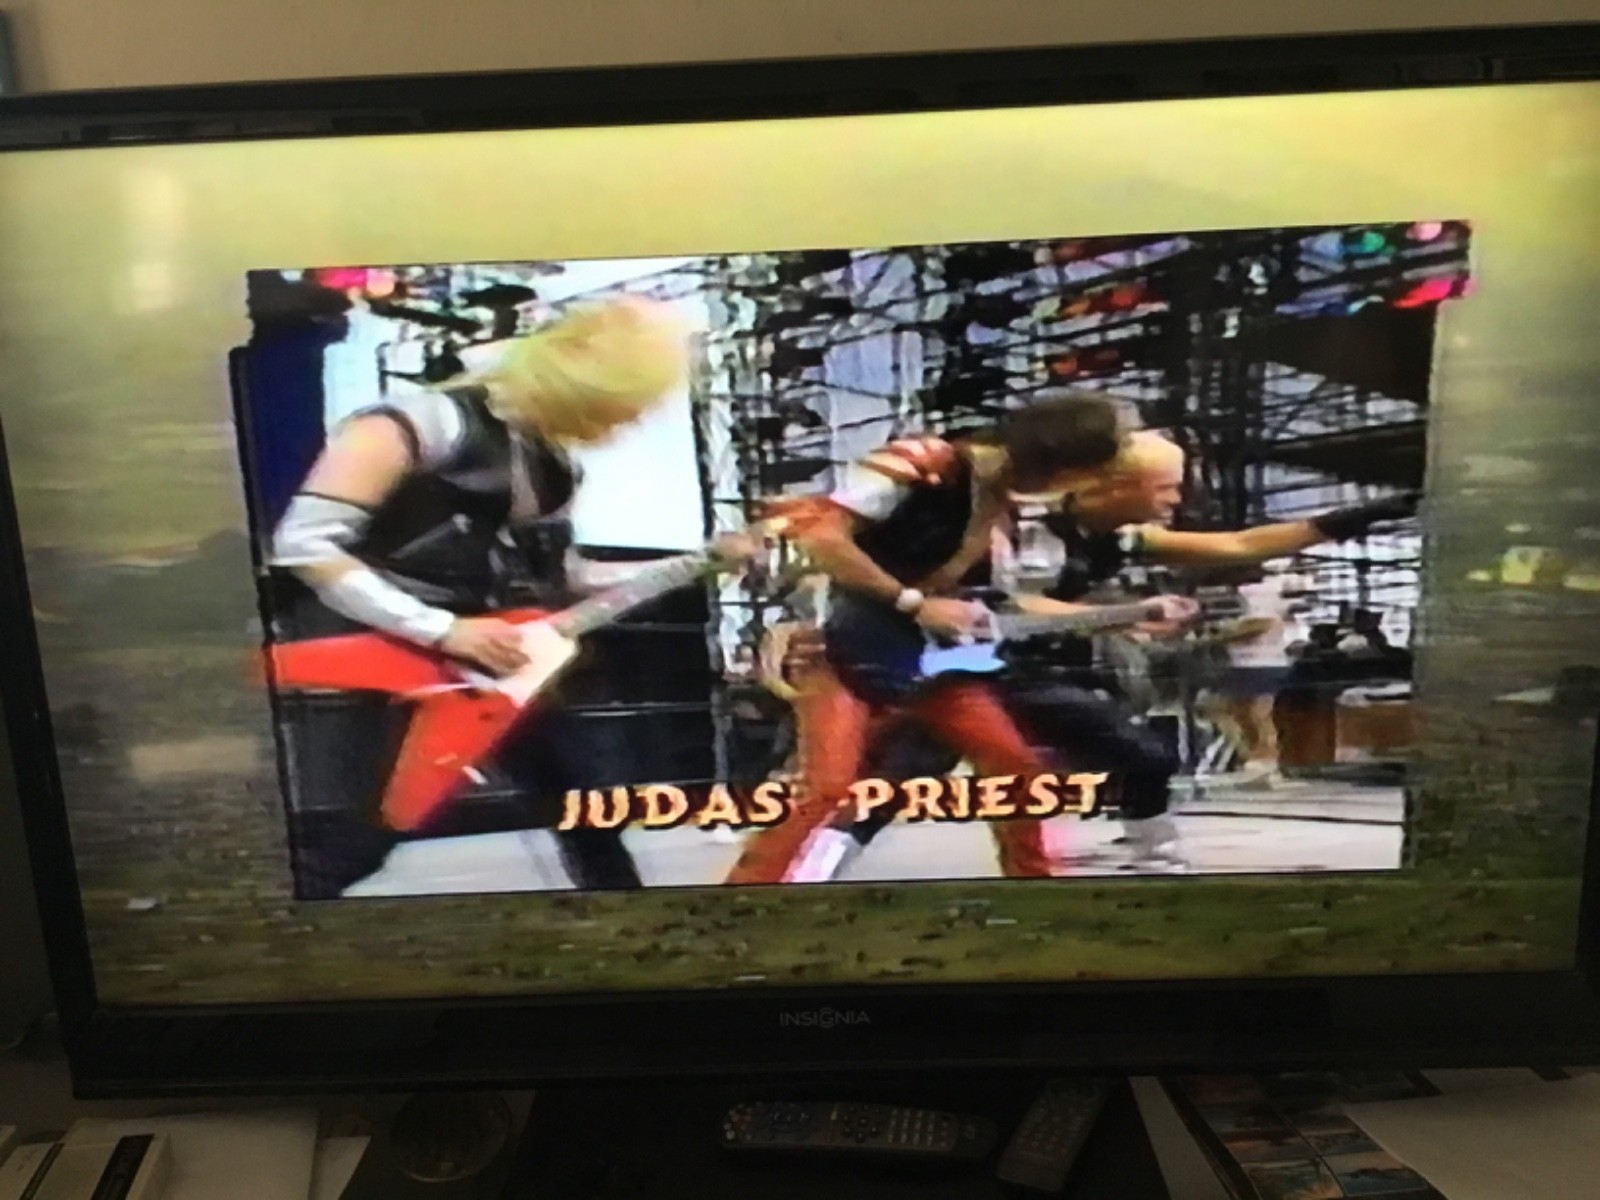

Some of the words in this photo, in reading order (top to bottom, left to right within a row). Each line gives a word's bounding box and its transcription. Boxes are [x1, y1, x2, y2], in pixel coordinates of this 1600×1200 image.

[558, 783, 788, 833] JUDAS
[851, 772, 1110, 823] PRIEST
[779, 1007, 871, 1028] INSIGNIA
